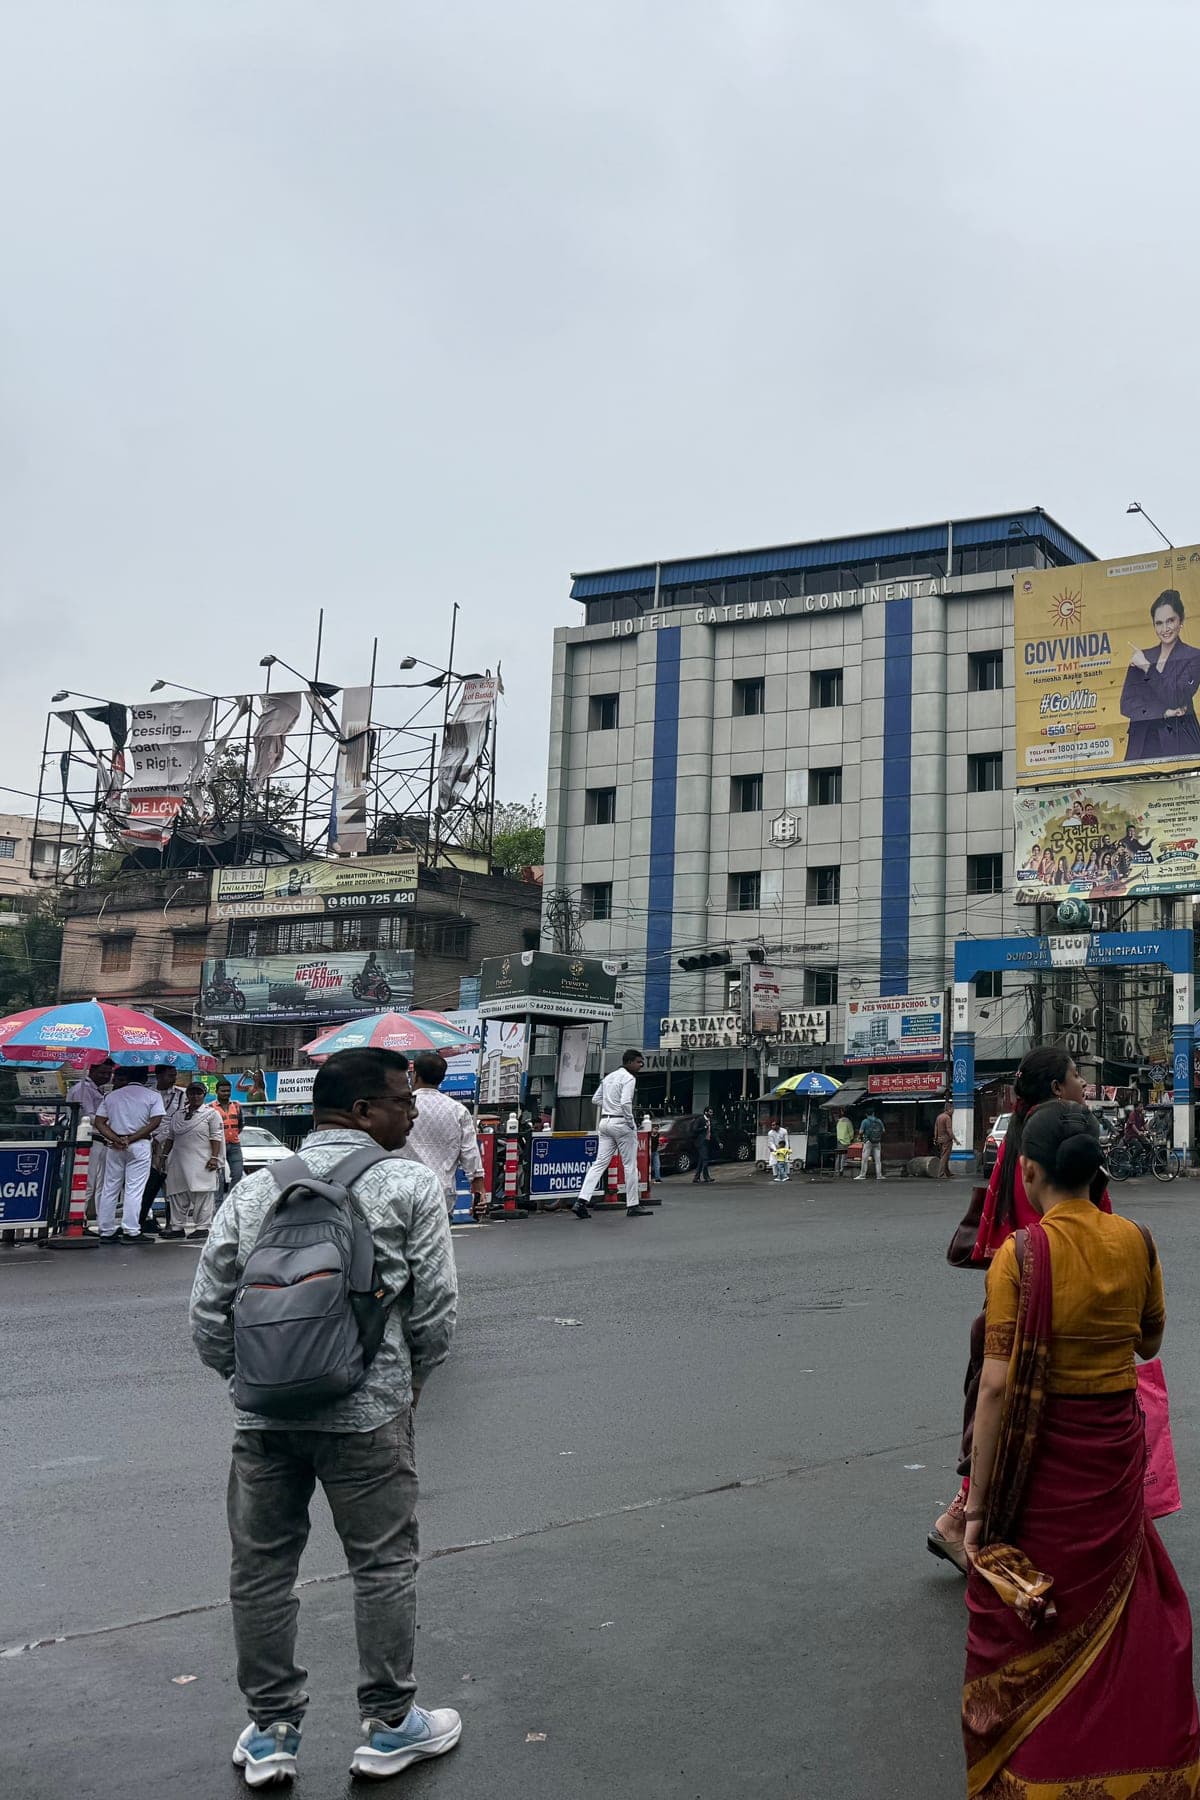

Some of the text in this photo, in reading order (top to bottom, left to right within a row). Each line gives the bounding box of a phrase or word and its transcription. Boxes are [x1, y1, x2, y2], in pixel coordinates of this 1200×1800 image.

[611, 578, 954, 636] HOTEL GATEWAY CONTINENTAL
[1025, 632, 1112, 665] GOVVINDA
[1056, 661, 1080, 672] TMT
[1033, 675, 1062, 685] Hamesha
[1040, 689, 1097, 714] #GoWin
[1058, 740, 1110, 753] 1800 123 4500
[1063, 823, 1099, 837] দমদম
[1050, 831, 1104, 854] উৎসব
[222, 869, 264, 882] ARENA
[336, 872, 368, 880] ANIMATION
[385, 868, 415, 879] GRAPHICS
[220, 884, 264, 893] ANIMATION
[354, 878, 385, 886] DESIGNING
[339, 892, 415, 908] 8100 725 420
[216, 899, 316, 917] KANKURGACHI
[1090, 944, 1160, 957] MUNICIPALITY
[295, 967, 327, 981] NEVER
[311, 975, 343, 990] DOWN
[877, 1002, 900, 1010] WORLD
[901, 1000, 928, 1009] SCHOOL
[661, 1016, 727, 1033] GATEWAY
[680, 1033, 720, 1047] HOTEL
[296, 1077, 314, 1085] GOVIND
[550, 1176, 583, 1190] POLICE
